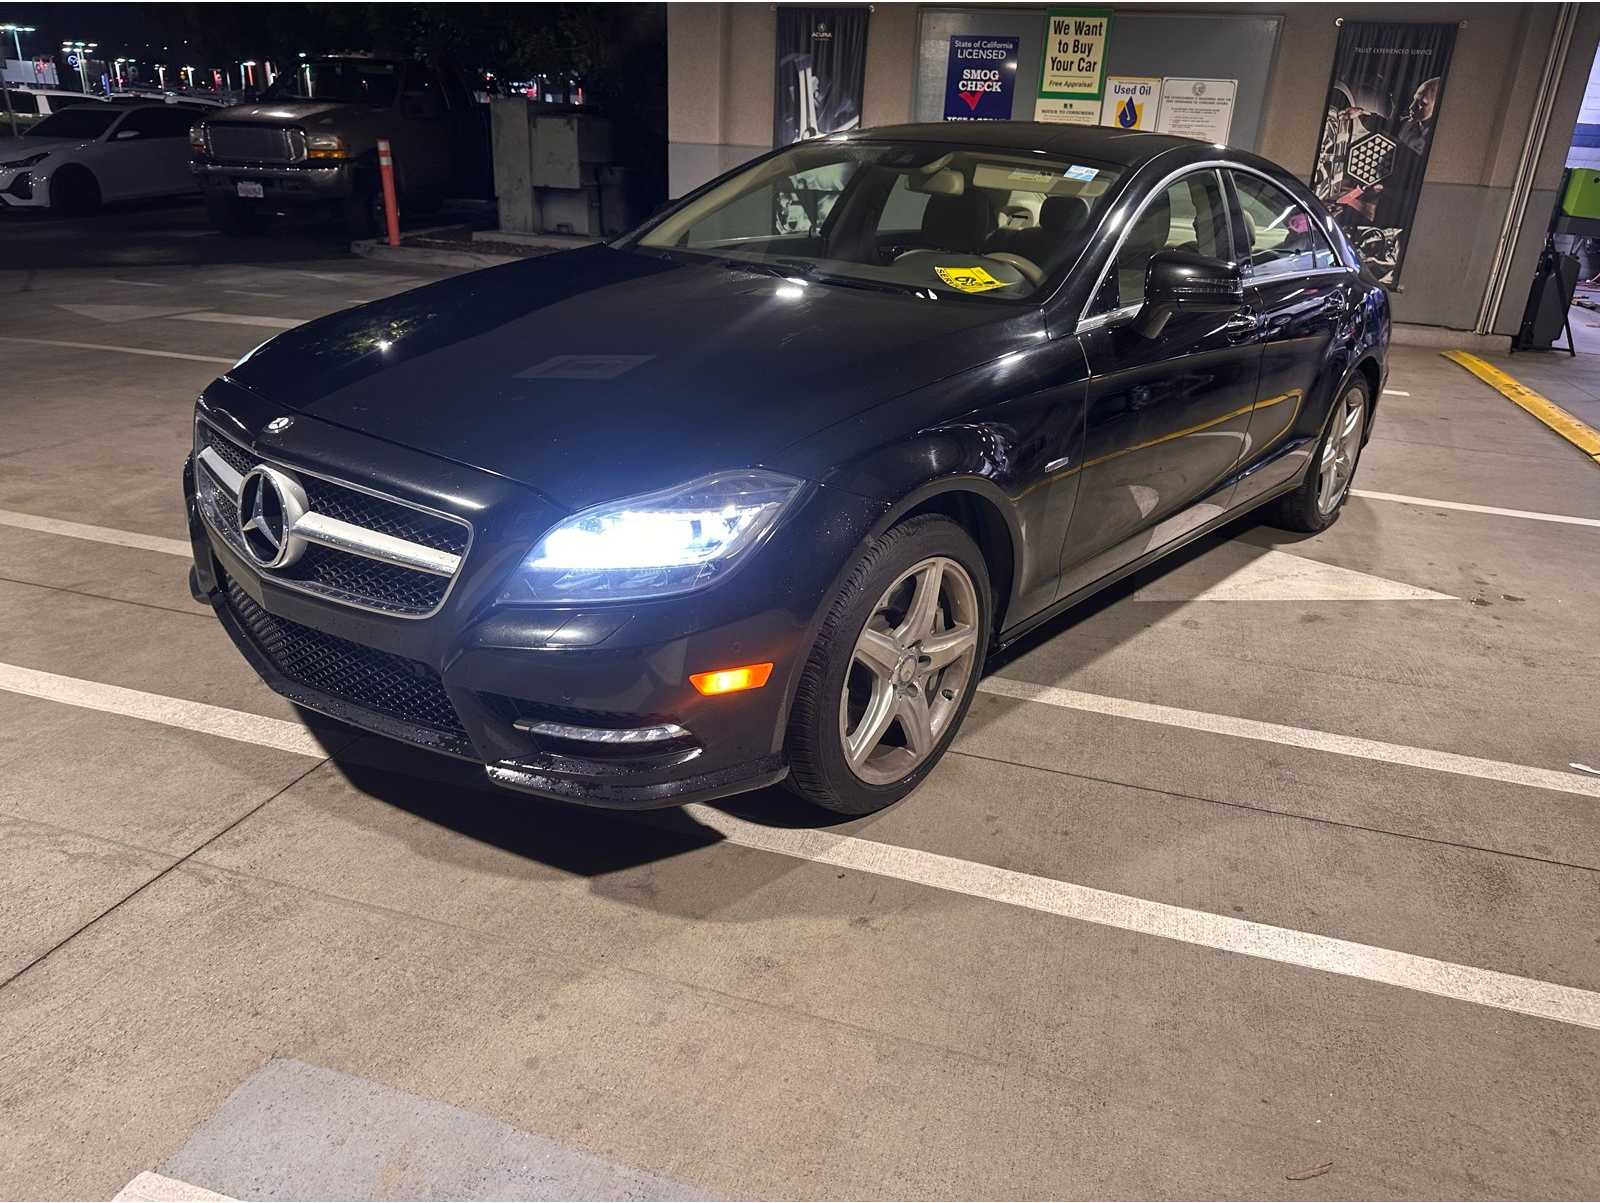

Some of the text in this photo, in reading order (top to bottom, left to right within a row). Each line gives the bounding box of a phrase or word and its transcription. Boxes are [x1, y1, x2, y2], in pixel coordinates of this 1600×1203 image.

[1053, 20, 1103, 36] We Want
[954, 40, 1014, 49] State of California
[1058, 39, 1093, 57] to Buy
[957, 48, 1007, 60] LICENSED
[1050, 56, 1098, 73] Your Car
[962, 68, 1000, 80] SMOG
[958, 80, 1003, 92] CHECK
[1114, 84, 1152, 96] Used Oil
